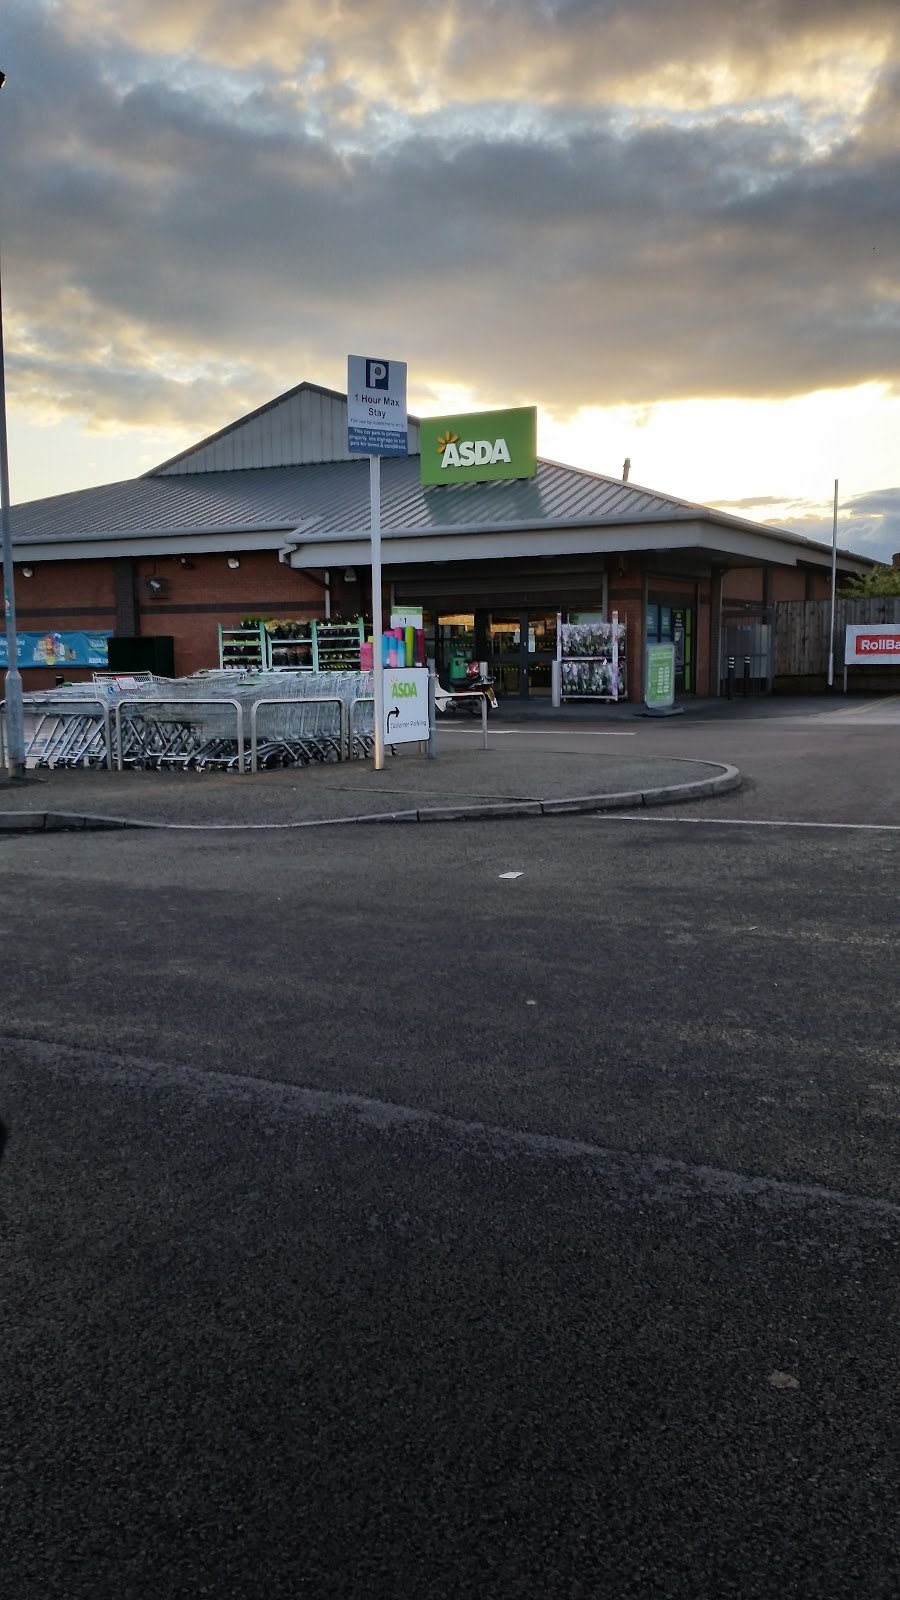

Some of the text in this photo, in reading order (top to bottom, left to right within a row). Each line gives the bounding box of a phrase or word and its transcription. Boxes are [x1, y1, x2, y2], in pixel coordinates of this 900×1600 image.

[370, 362, 386, 387] P
[354, 393, 399, 406] 1 Hour Max
[368, 407, 386, 419] Stay
[441, 439, 511, 468] ASDA
[392, 682, 417, 699] ASDA
[390, 721, 410, 729] Customer
